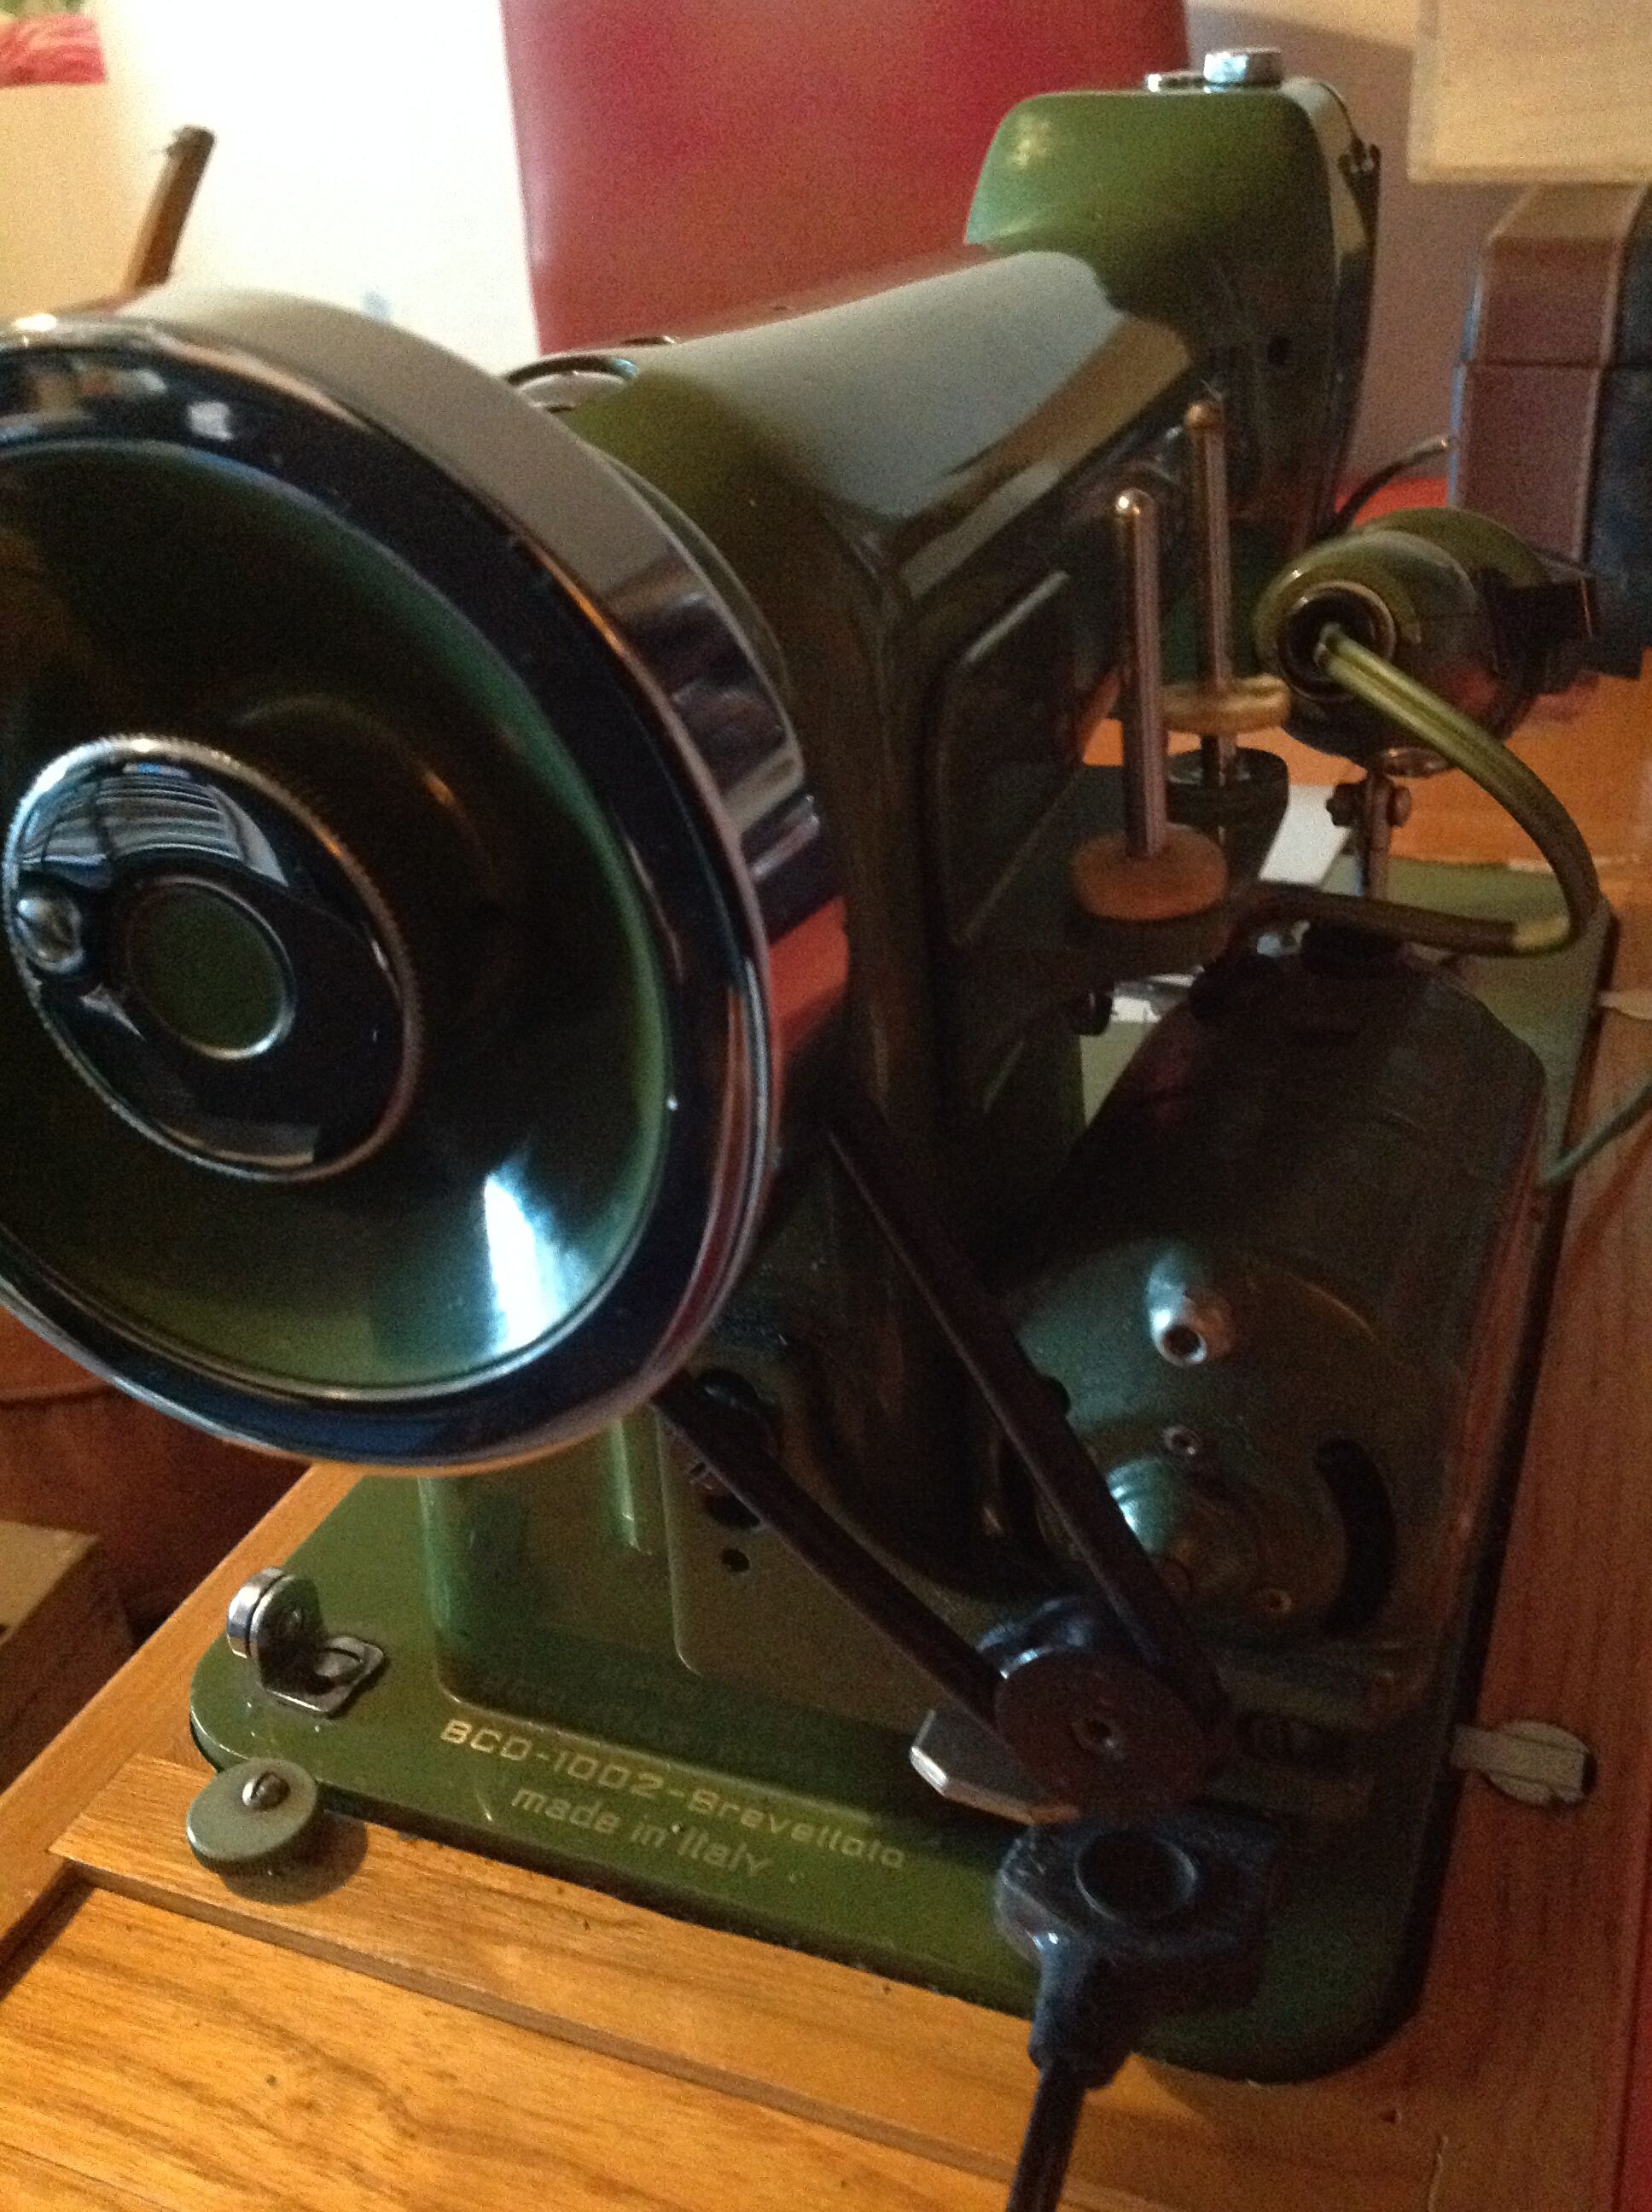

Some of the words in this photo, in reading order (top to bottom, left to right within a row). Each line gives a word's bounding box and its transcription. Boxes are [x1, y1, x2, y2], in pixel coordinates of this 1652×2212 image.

[511, 1787, 620, 1835] made
[630, 1815, 669, 1848] in
[678, 1825, 773, 1877] Italy
